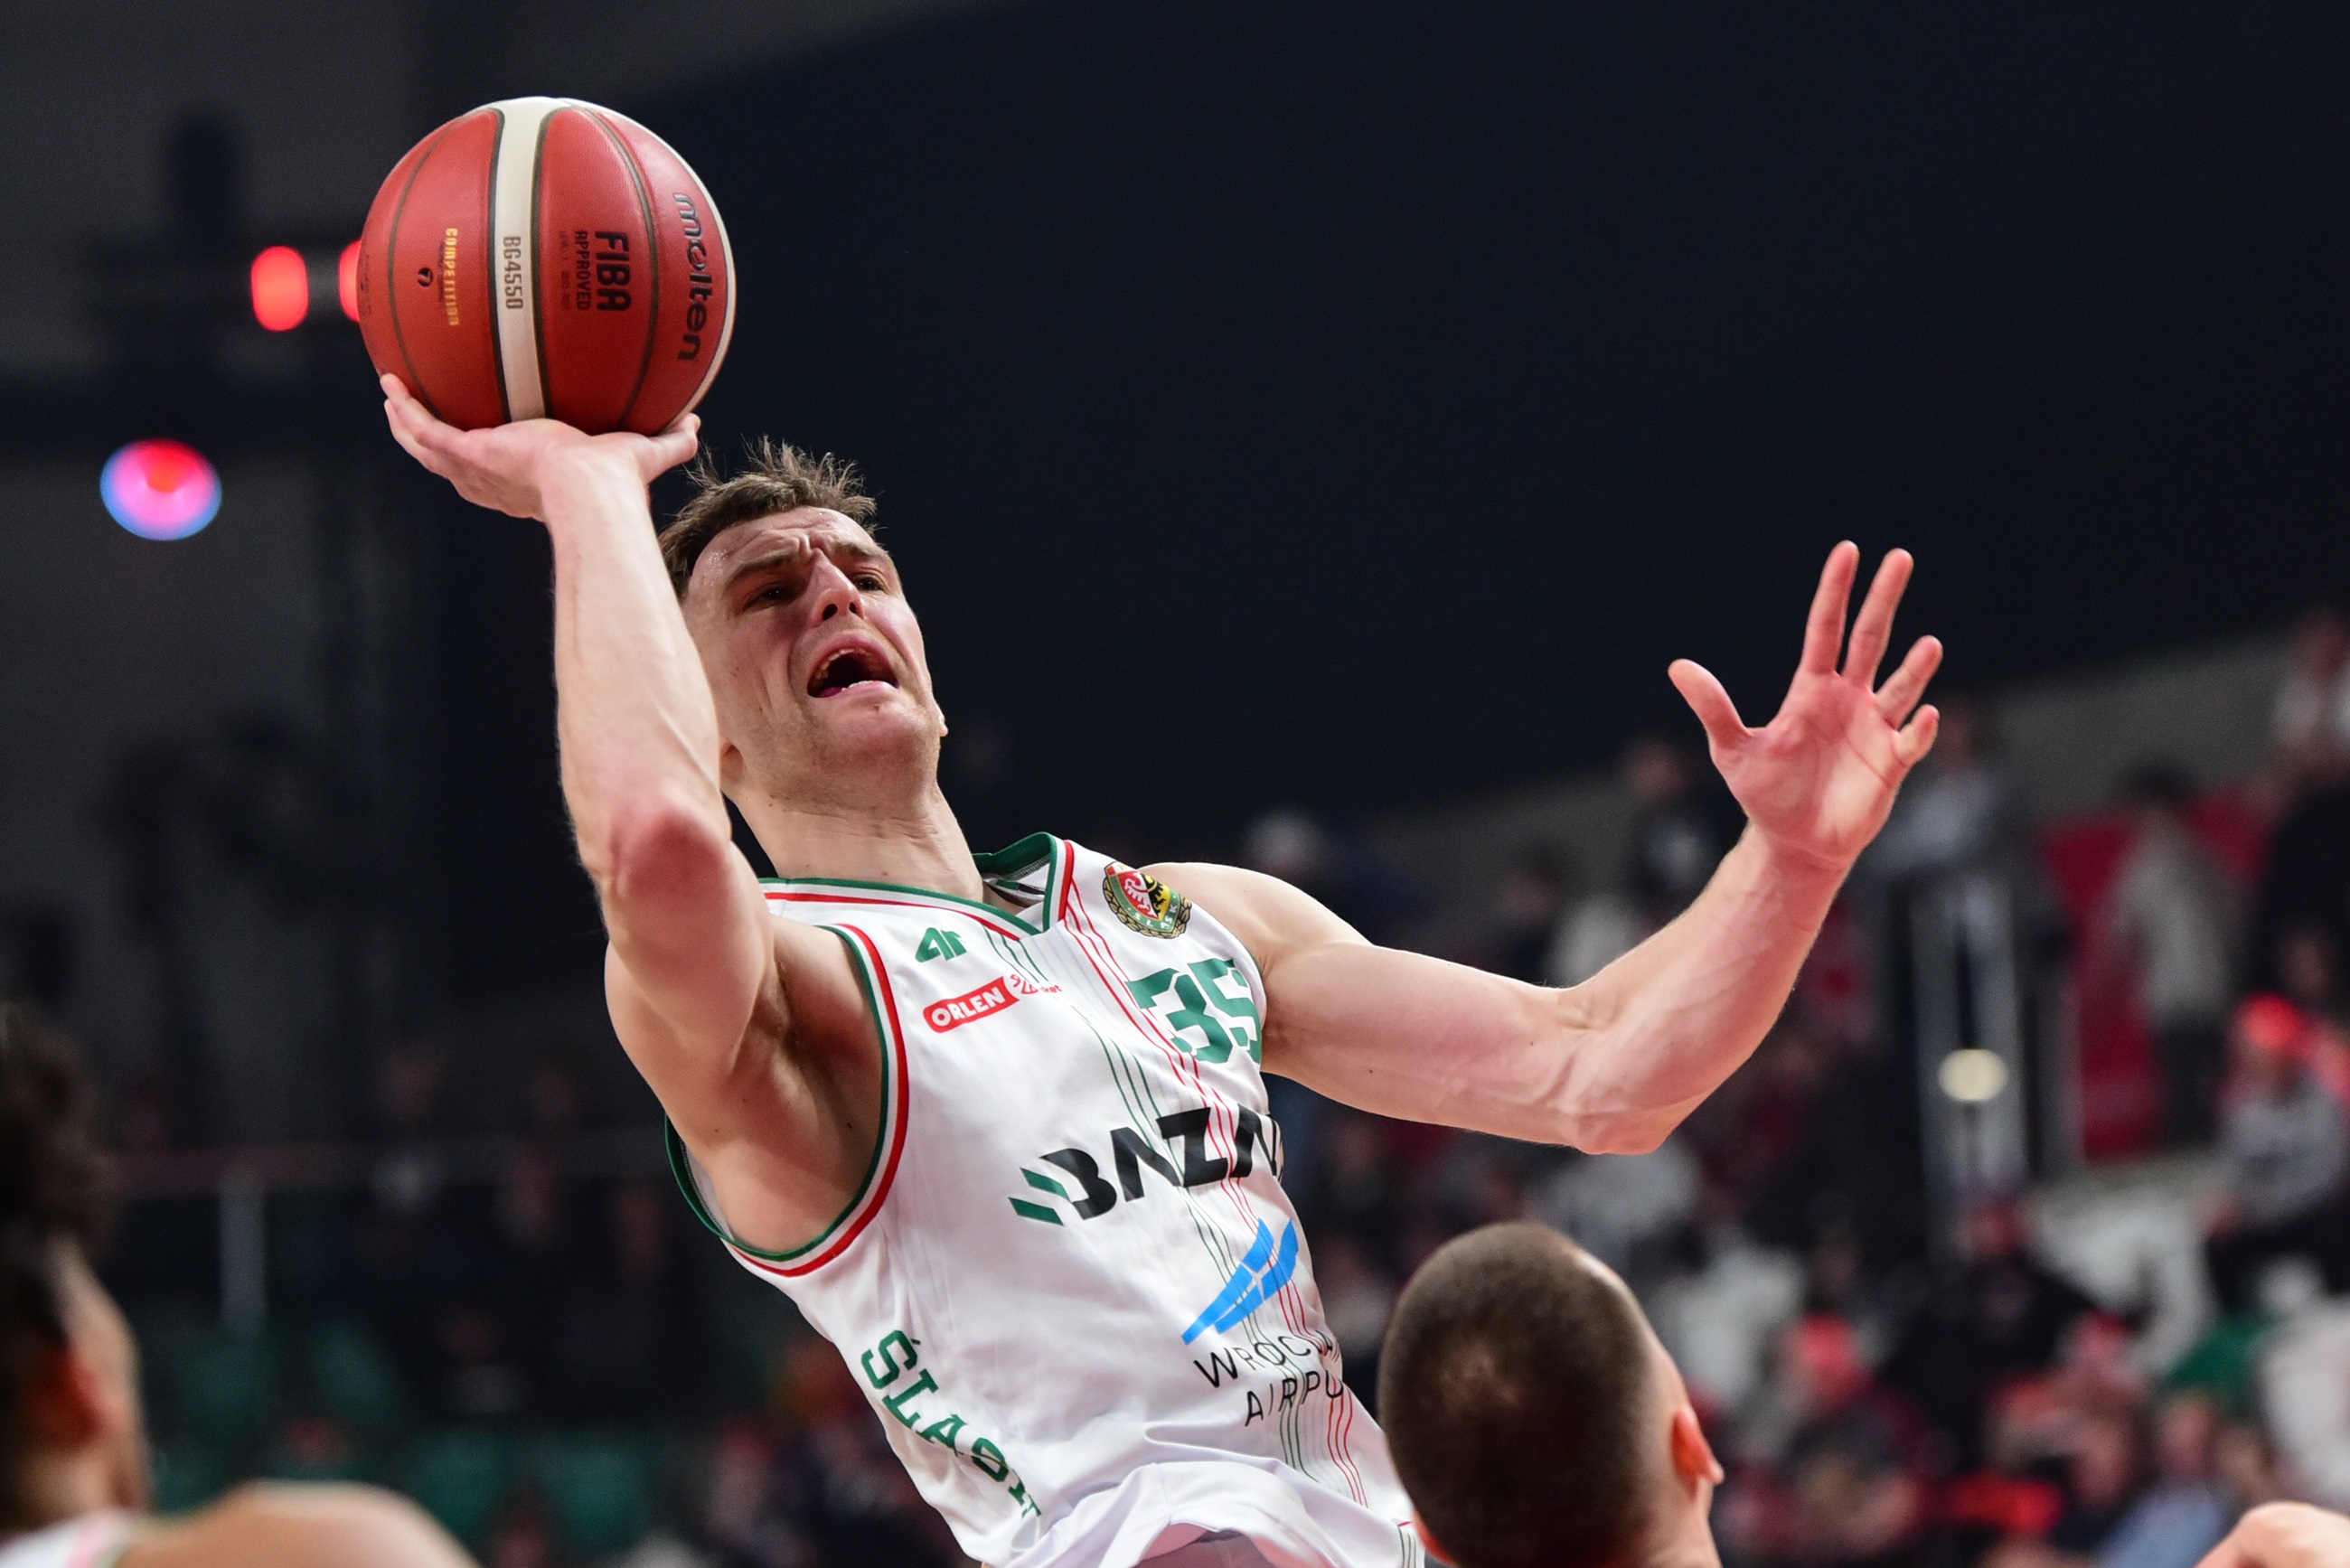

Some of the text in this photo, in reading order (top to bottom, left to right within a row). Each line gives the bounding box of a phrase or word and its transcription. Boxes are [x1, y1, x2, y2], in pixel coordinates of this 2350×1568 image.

[418, 268, 432, 286] 7
[444, 228, 459, 325] COMPETITION
[503, 236, 523, 310] BG4550
[575, 230, 591, 310] APPROVED
[595, 230, 631, 311] FIBA
[673, 192, 712, 360] molten
[932, 986, 1006, 1027] ORLEN
[1125, 959, 1262, 1065] 35
[1193, 1329, 1334, 1388] WROC
